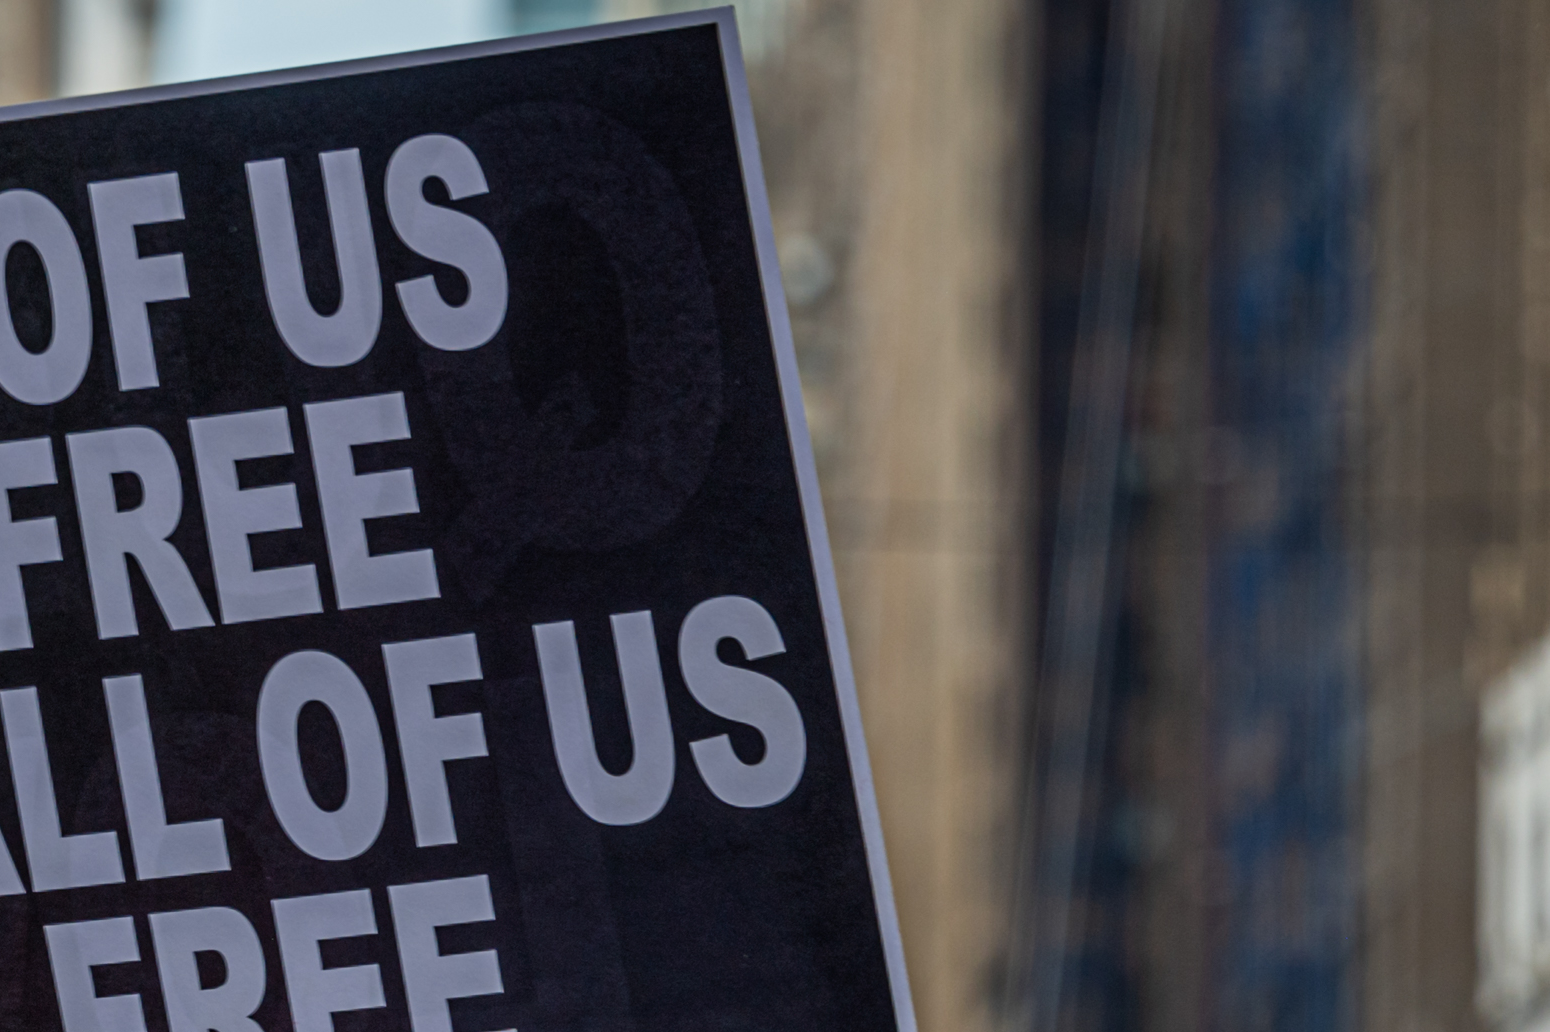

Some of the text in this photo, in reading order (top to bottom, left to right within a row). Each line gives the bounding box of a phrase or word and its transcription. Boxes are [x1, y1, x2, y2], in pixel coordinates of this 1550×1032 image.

[245, 135, 507, 367] US
[257, 633, 489, 860] OF
[532, 596, 806, 825] US
